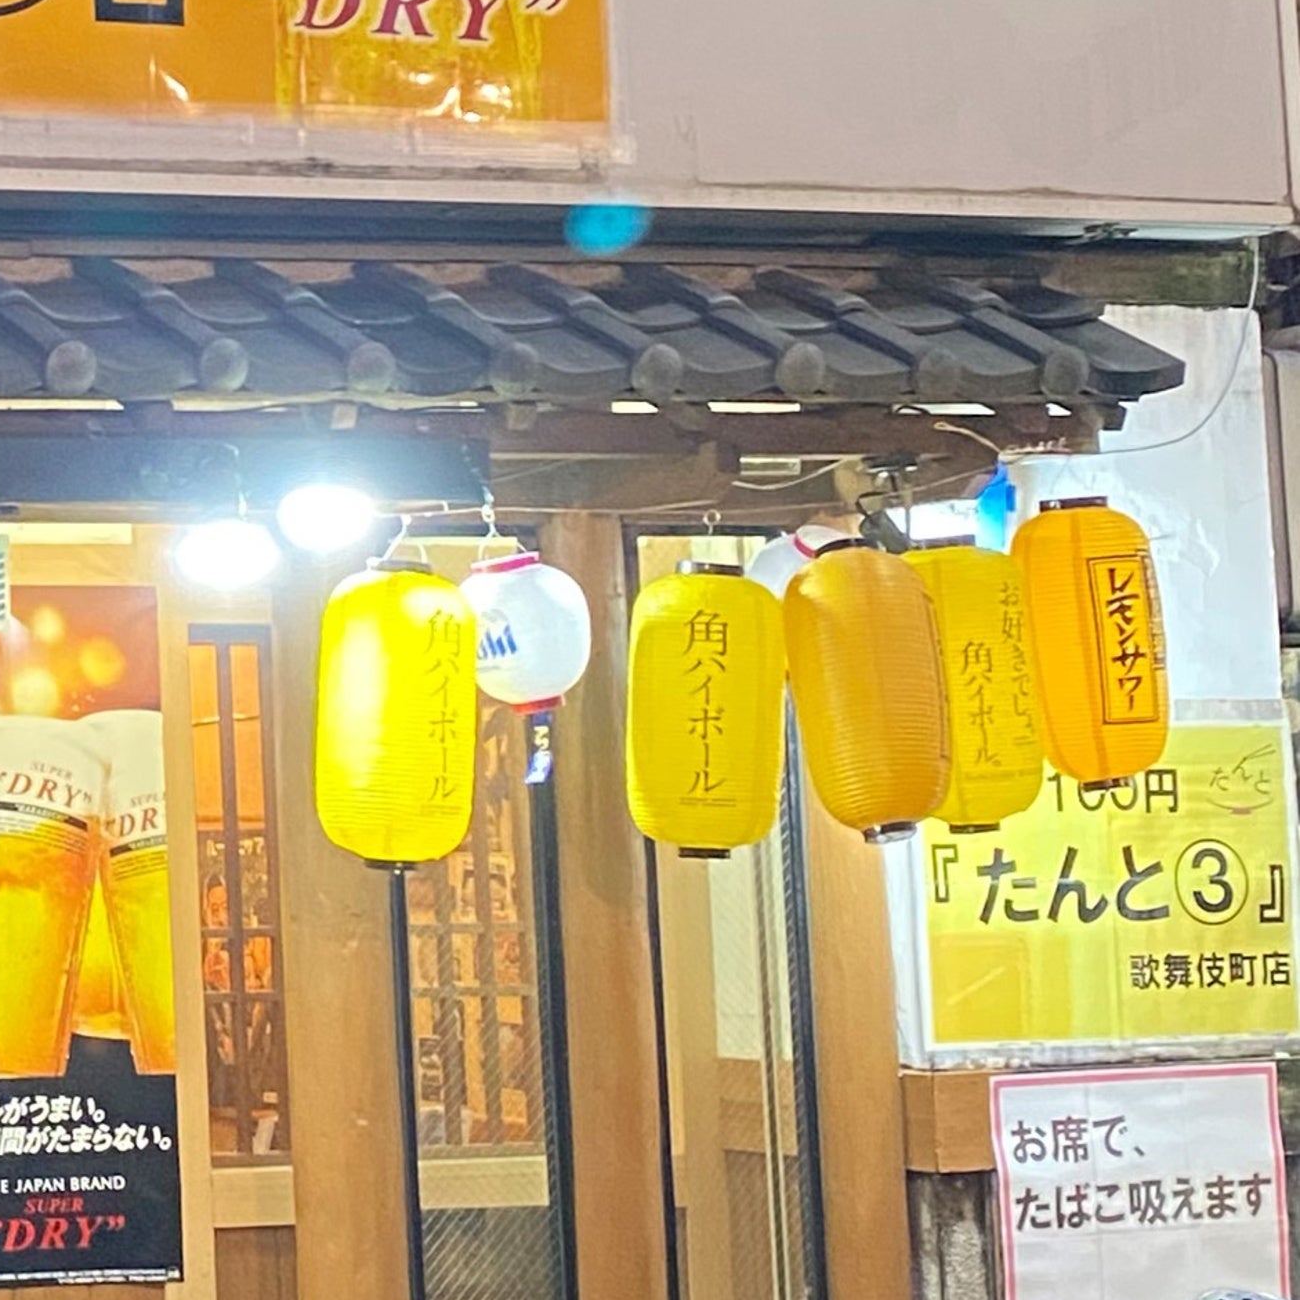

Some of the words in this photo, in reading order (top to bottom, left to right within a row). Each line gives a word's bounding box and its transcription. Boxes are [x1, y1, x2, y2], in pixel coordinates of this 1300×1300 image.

[1105, 567, 1147, 712] レモンサワー
[423, 609, 463, 801] 角ハイボール
[682, 608, 729, 796] 角ハイボール
[1129, 952, 1292, 990] 歌舞伎町店
[1011, 1115, 1145, 1163] お席で、
[14, 1177, 66, 1193] JAPAN
[70, 1175, 126, 1191] BRAND
[24, 1197, 84, 1214] SUPER
[1016, 1173, 1271, 1231] たばこ吸えます
